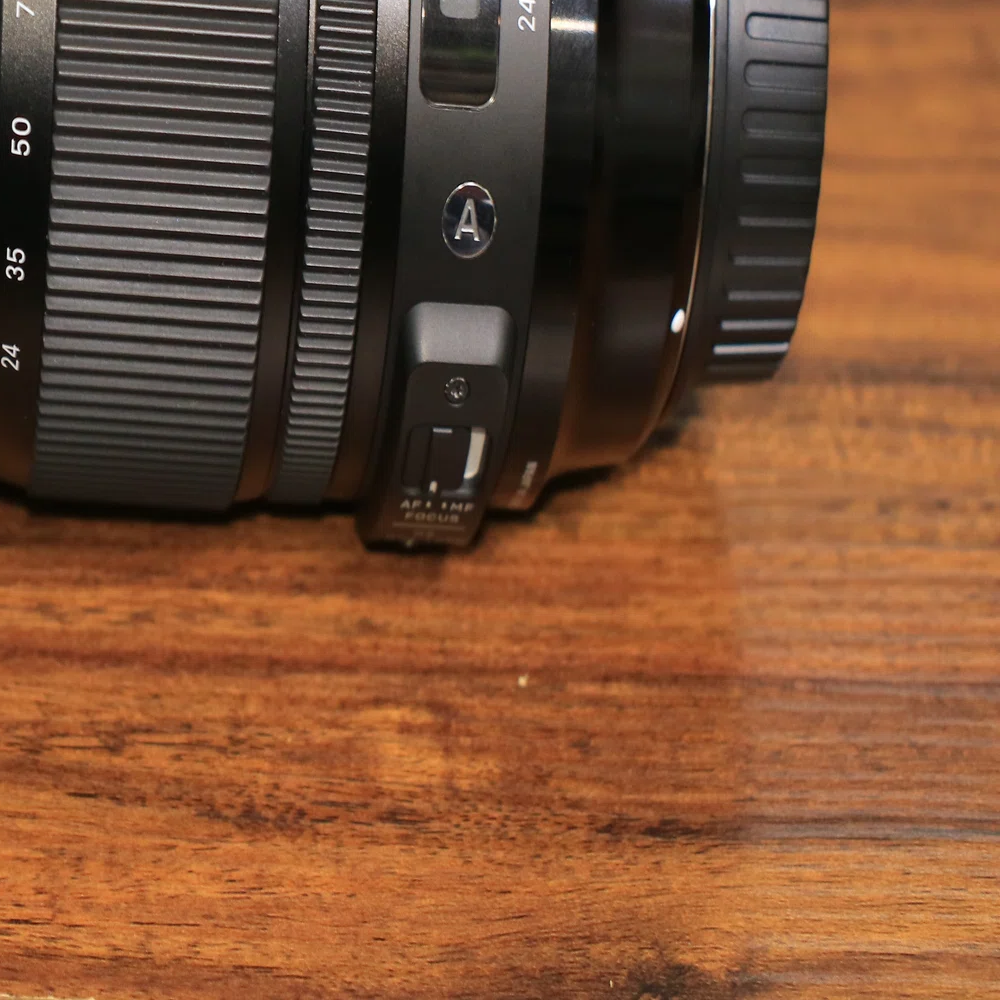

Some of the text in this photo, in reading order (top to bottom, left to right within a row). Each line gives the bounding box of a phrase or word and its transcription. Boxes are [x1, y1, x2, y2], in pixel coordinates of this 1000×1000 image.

[11, 116, 31, 156] 50
[454, 198, 480, 242] A
[5, 247, 26, 281] 35
[0, 343, 20, 371] 24
